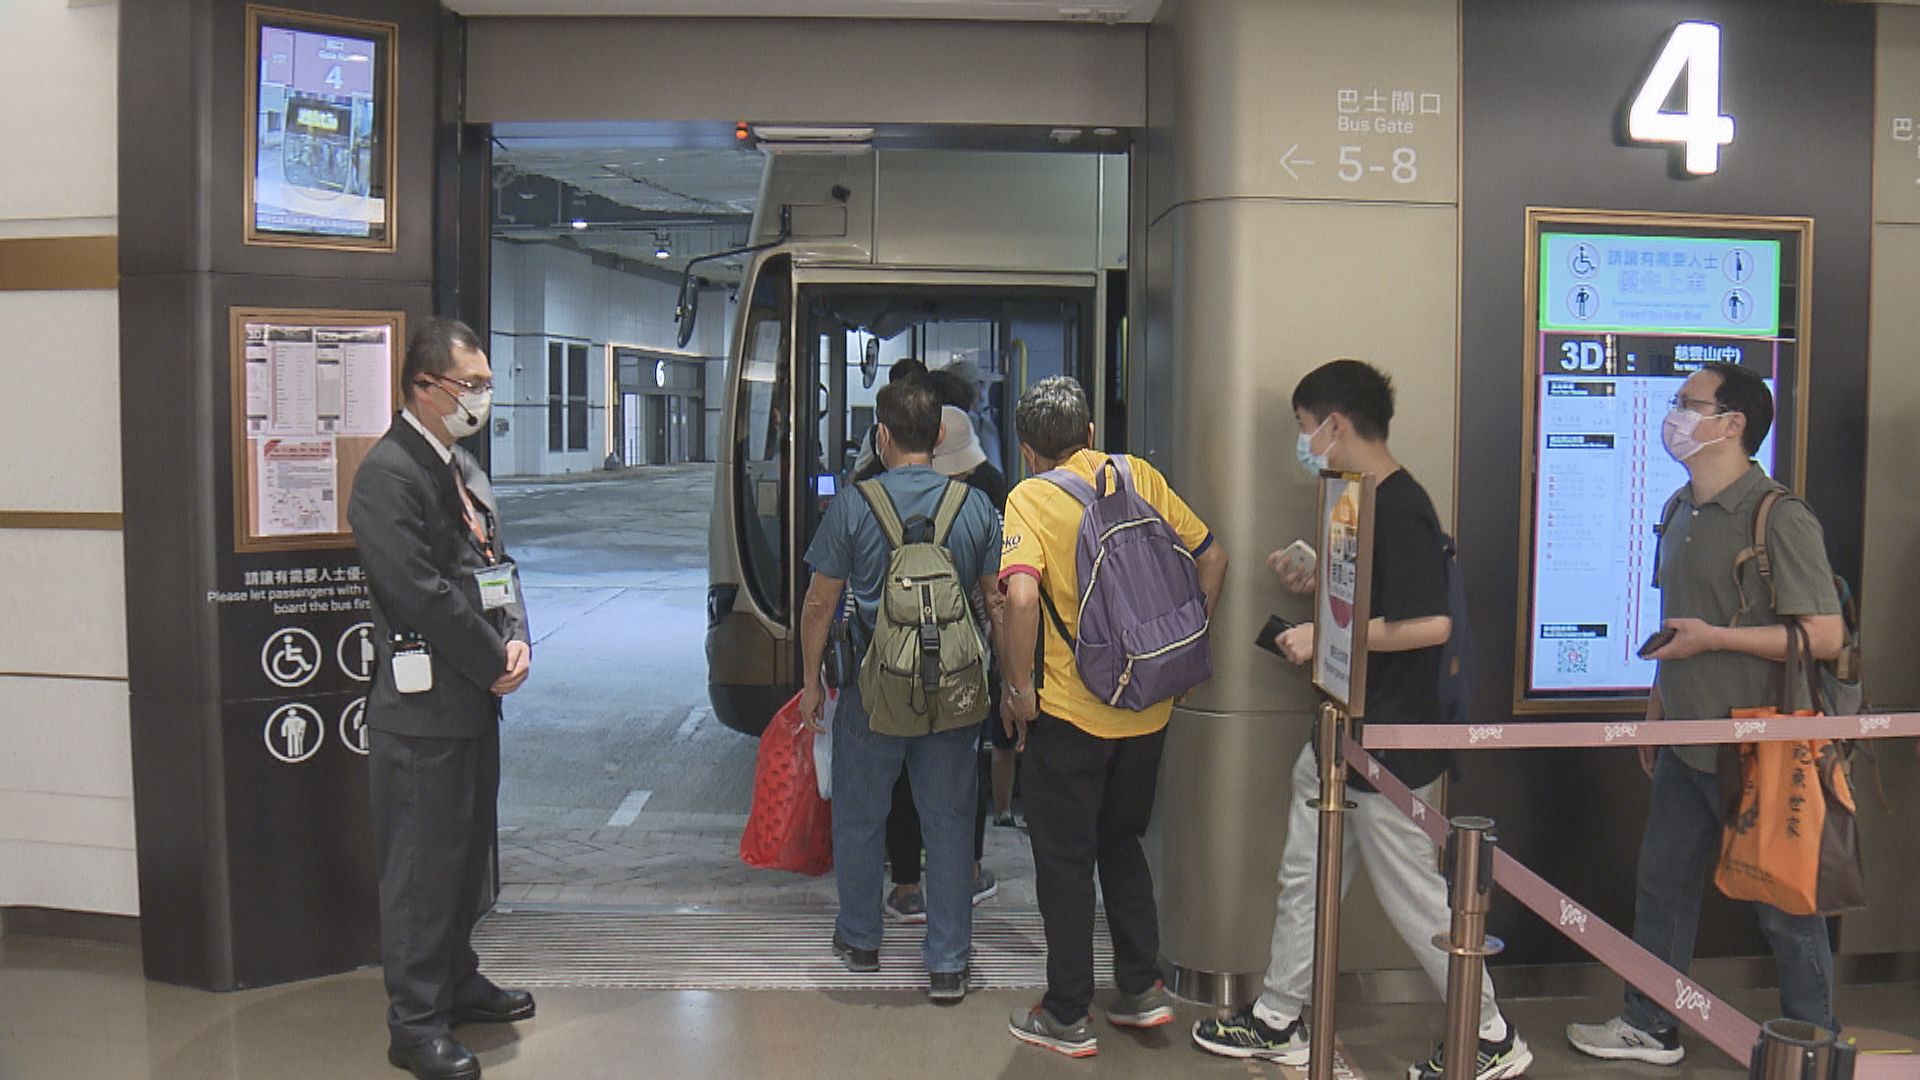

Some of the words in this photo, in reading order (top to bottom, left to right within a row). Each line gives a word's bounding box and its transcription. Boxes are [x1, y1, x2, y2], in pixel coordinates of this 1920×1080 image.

[325, 65, 344, 90] 4
[1338, 89, 1441, 115] 巴士閘口
[1629, 21, 1735, 174] 4
[1338, 116, 1371, 132] Bus
[1374, 117, 1414, 133] Gate
[1893, 118, 1920, 141] 巴
[1338, 146, 1418, 183] 5-8
[1560, 341, 1605, 371] 3D
[656, 360, 665, 387] 6
[206, 590, 248, 603] Please
[250, 589, 266, 600] let
[268, 586, 335, 601] passengers
[336, 584, 362, 596] with
[273, 602, 307, 615] board
[308, 600, 329, 612] the
[330, 599, 352, 612] bus
